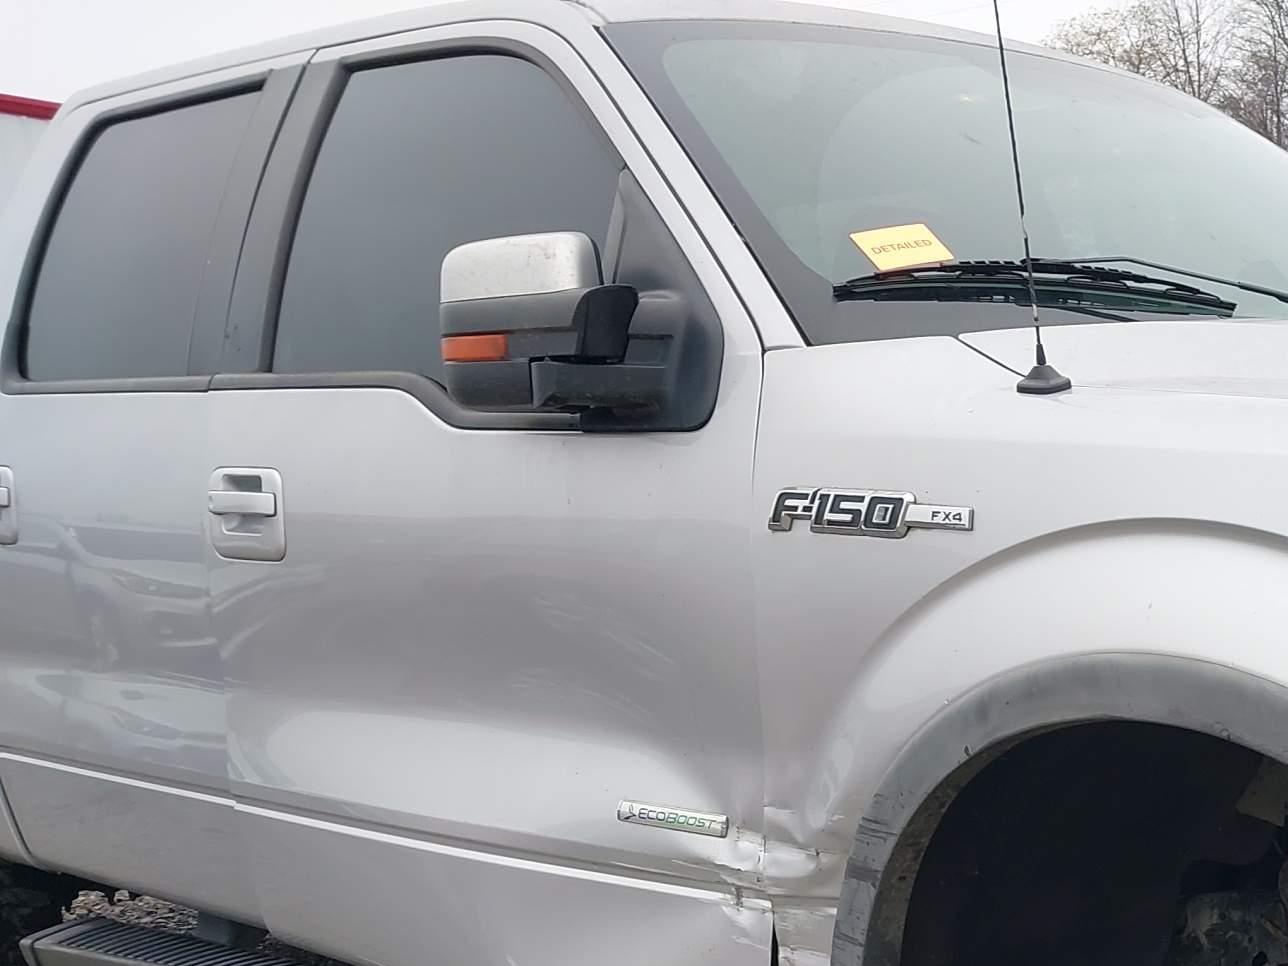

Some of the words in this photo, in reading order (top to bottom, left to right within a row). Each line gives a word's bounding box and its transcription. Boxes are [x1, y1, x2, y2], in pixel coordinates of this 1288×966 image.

[870, 239, 933, 255] DETAILED
[770, 489, 908, 535] F-150
[930, 511, 963, 523] FX4
